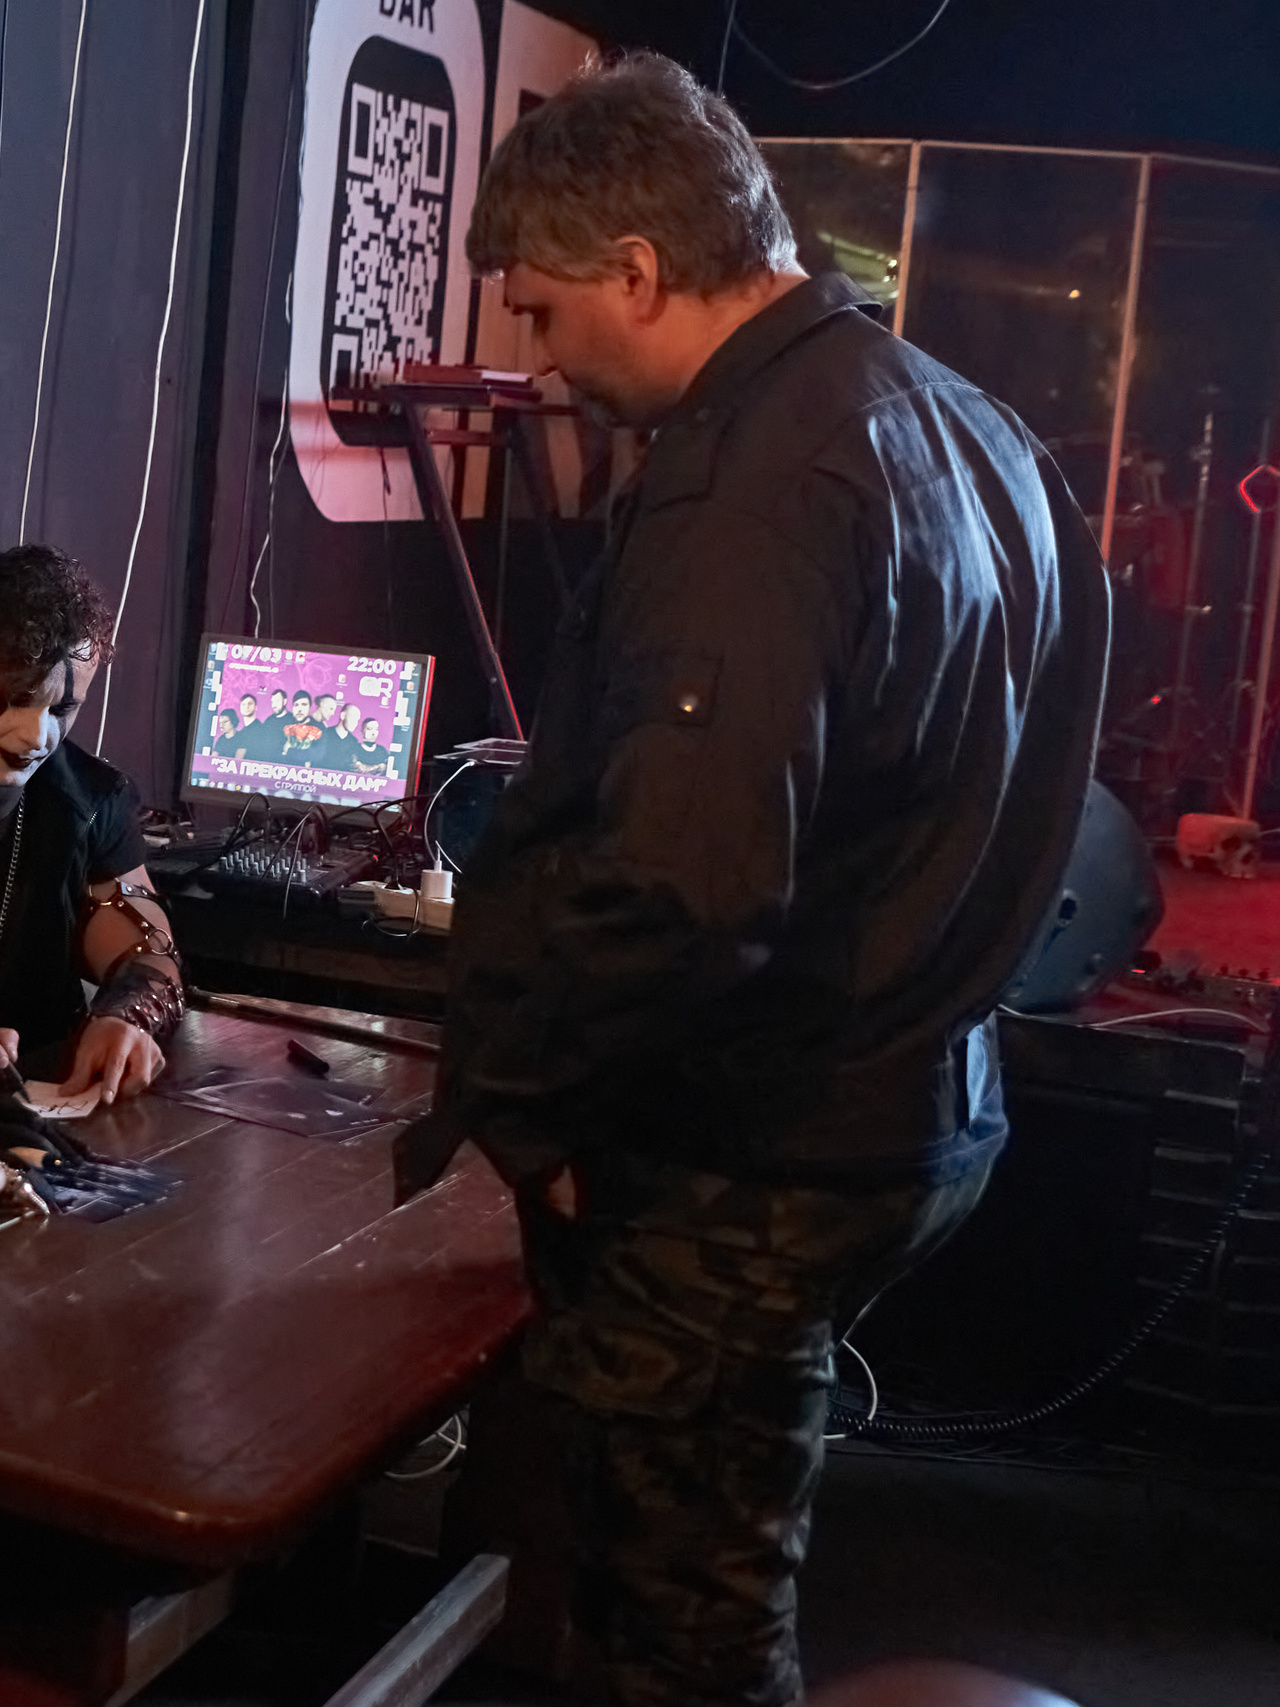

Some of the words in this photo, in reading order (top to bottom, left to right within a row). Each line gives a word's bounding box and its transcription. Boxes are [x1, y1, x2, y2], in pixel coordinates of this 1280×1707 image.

[231, 644, 282, 663] 07/03
[347, 656, 396, 675] 22:00
[239, 761, 342, 787] ПРЕКРАСНЫХ
[281, 782, 317, 793] ГРУППОЙ
